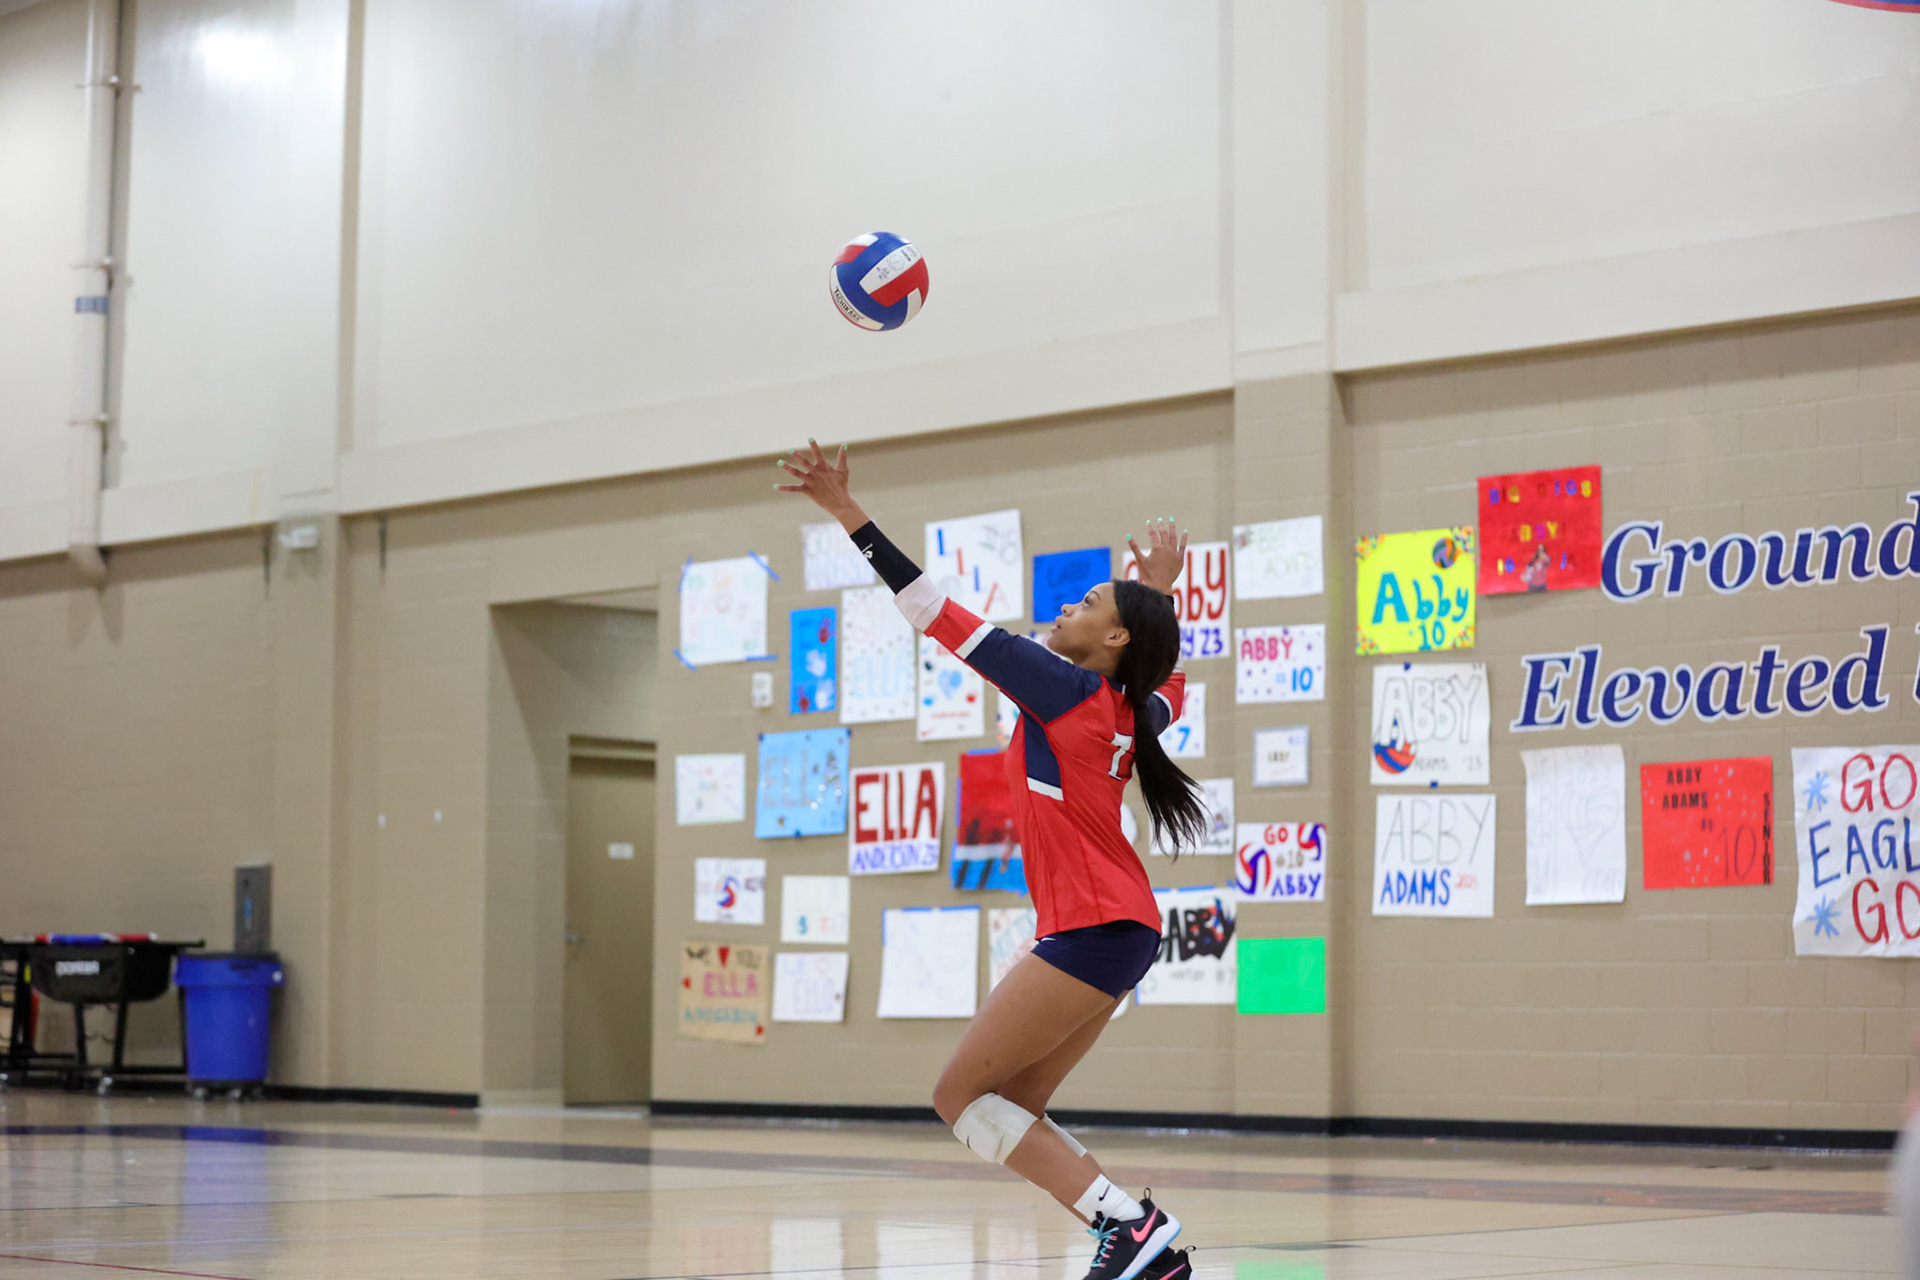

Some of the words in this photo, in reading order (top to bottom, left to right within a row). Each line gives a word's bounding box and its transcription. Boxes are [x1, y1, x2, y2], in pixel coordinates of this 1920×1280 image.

[1372, 572, 1469, 625] Abby
[1200, 627, 1223, 655] 23
[1241, 637, 1293, 662] ABBY
[1509, 623, 1890, 732] Elevated
[1379, 673, 1482, 752] ABBY
[1108, 731, 1133, 781] 7
[1666, 766, 1702, 786] ABBY
[1841, 753, 1917, 813] GO
[855, 769, 937, 844] ELLA
[1662, 792, 1708, 810] ADAMS
[1264, 824, 1288, 845] GO
[1381, 797, 1492, 866] ABBY
[1271, 873, 1321, 897] ABBY
[1380, 868, 1451, 906] ADAMS
[703, 972, 757, 998] ELLA
